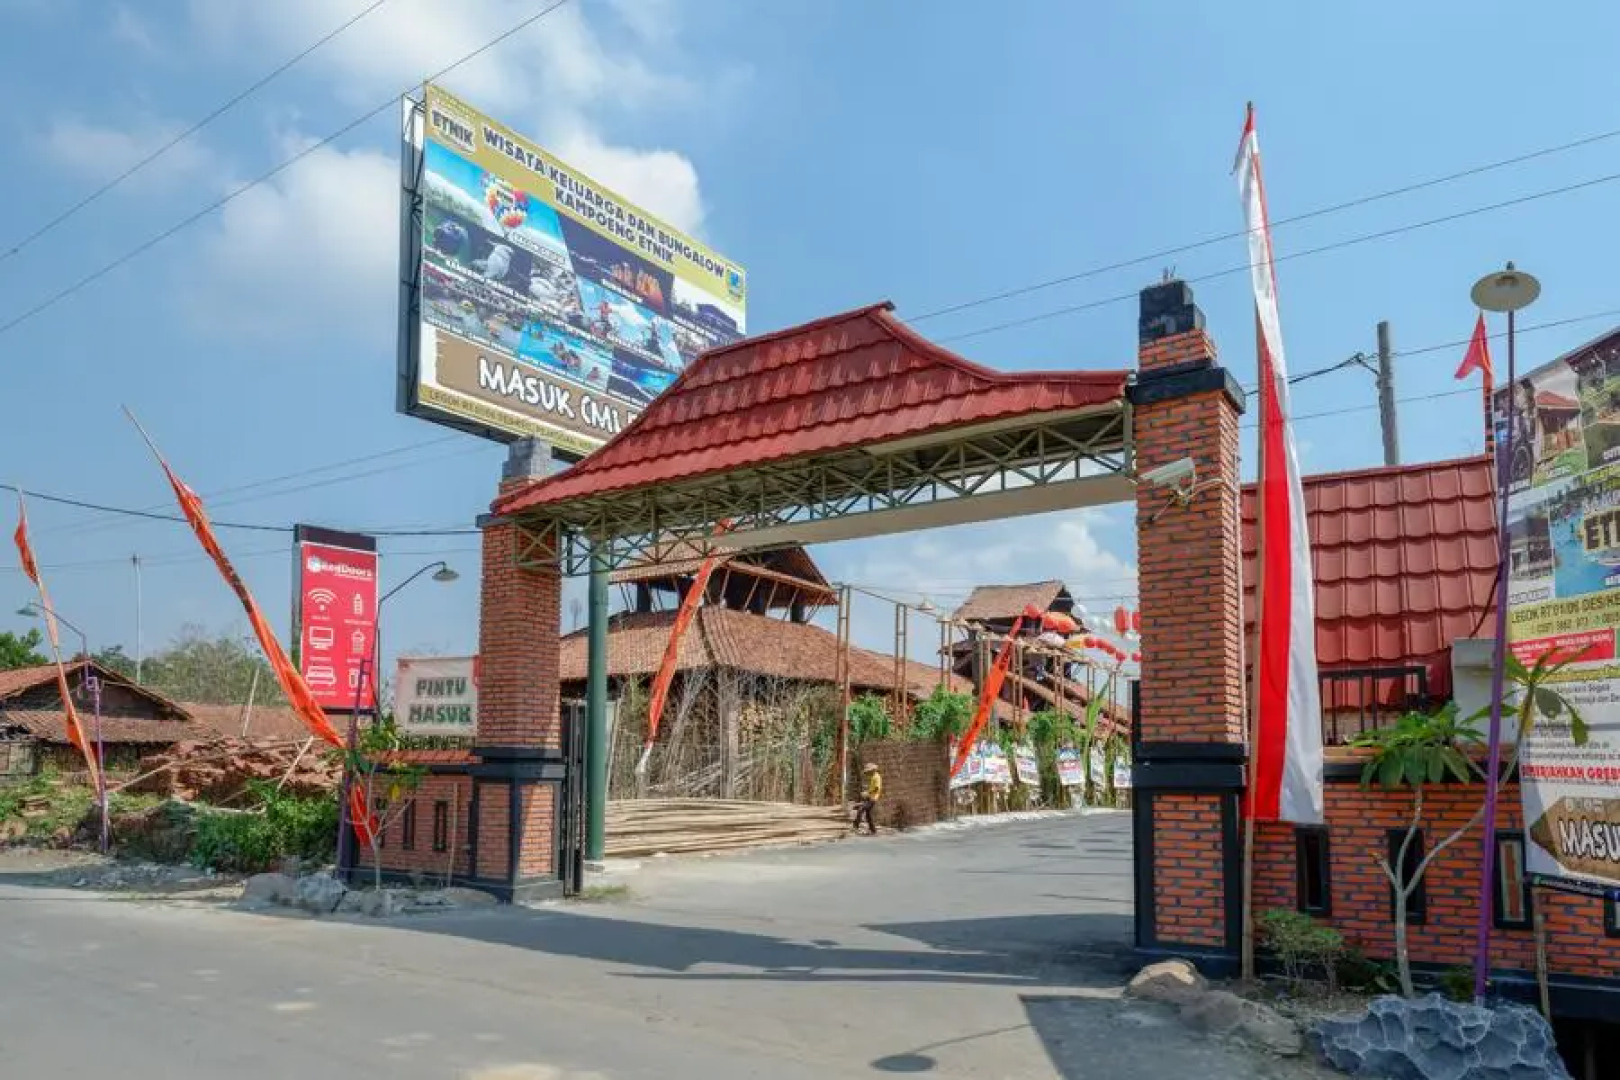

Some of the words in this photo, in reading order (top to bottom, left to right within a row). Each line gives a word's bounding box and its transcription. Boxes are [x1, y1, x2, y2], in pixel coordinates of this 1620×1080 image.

[431, 110, 473, 146] ETNIK
[482, 126, 545, 175] WISATA
[549, 166, 625, 222] KELUARGA
[627, 212, 656, 238] DAN
[658, 229, 725, 278] BUNGALOW
[554, 186, 635, 243] KAMPOENG
[638, 234, 674, 265] ETNIK
[478, 356, 575, 420] MASUK
[415, 677, 468, 696] PINTU
[408, 703, 472, 724] MASUK
